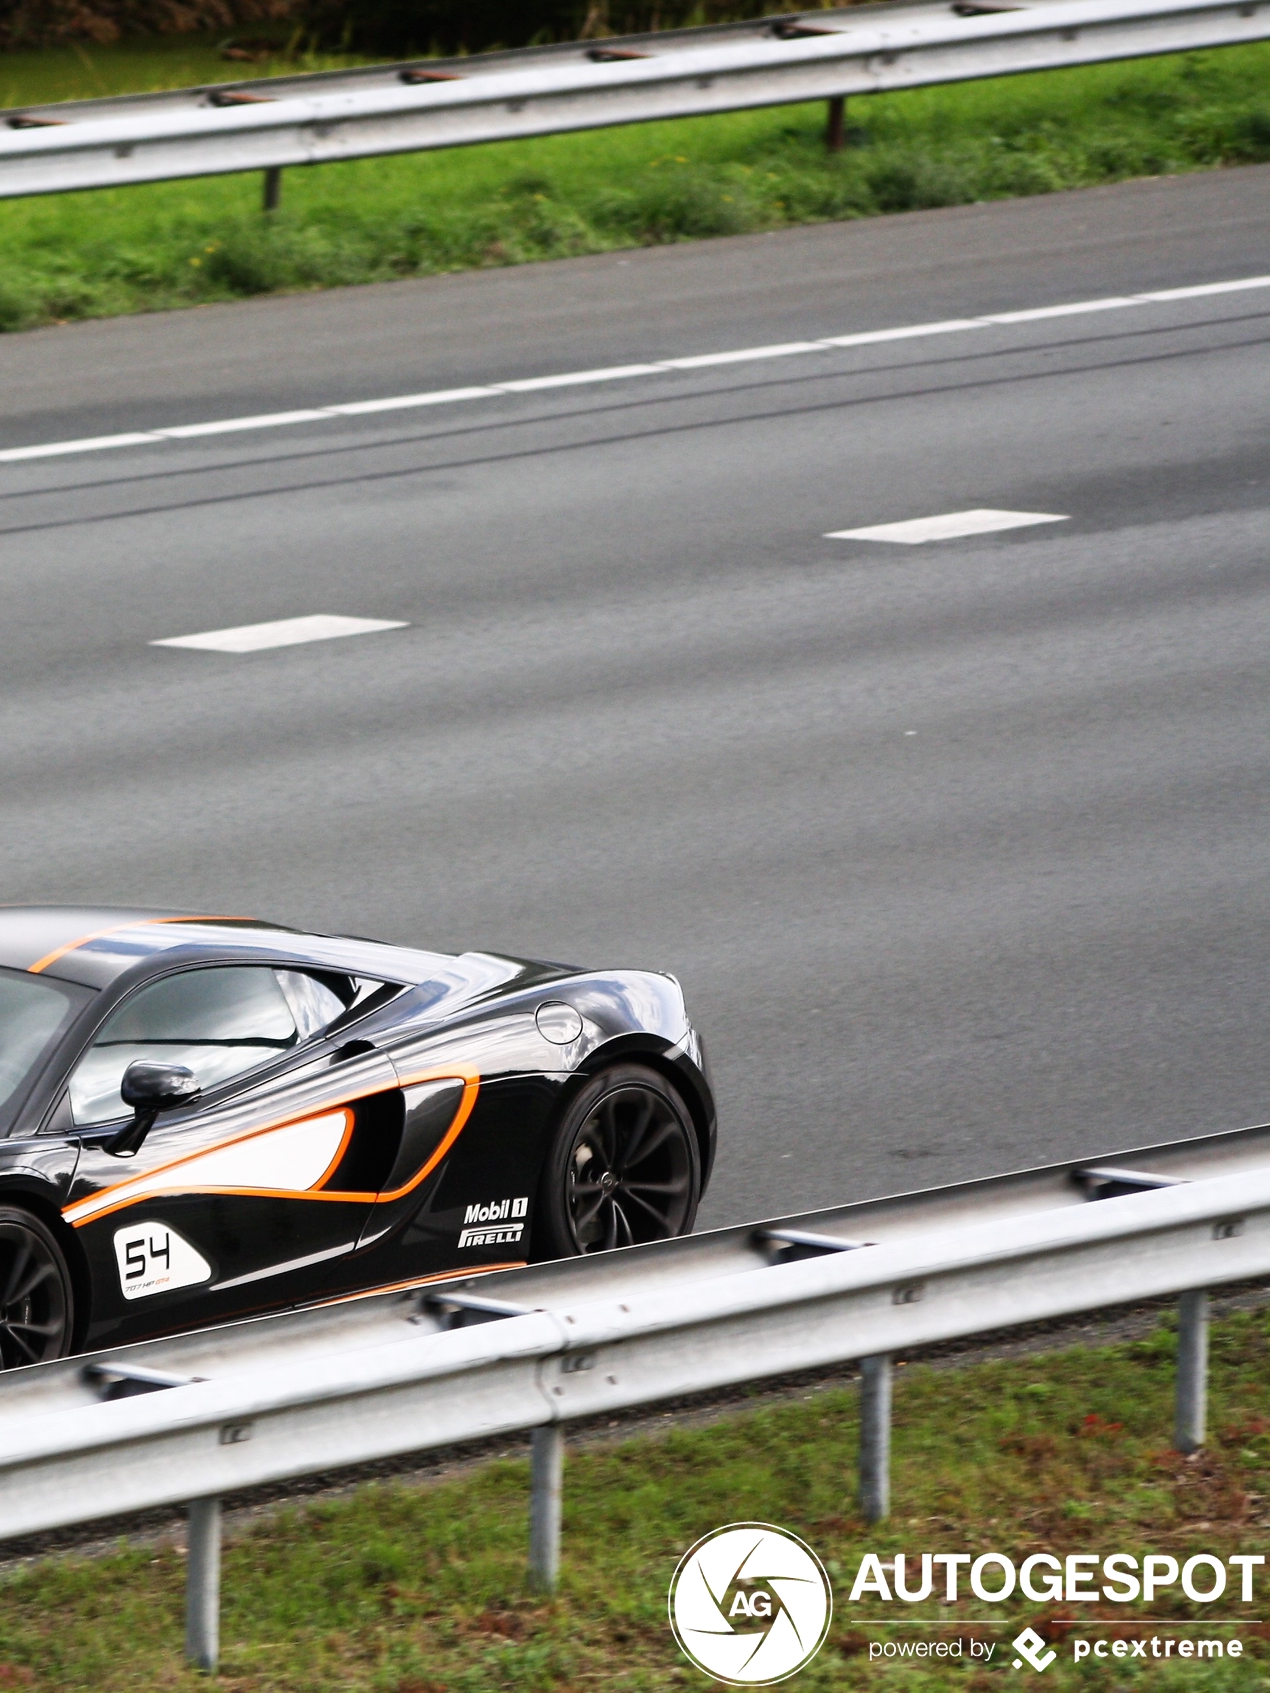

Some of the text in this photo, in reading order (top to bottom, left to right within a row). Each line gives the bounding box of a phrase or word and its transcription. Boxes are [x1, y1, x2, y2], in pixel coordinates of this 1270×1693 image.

[463, 1199, 510, 1224] Mobil
[457, 1223, 525, 1248] PIRELLI
[125, 1232, 170, 1280] 54
